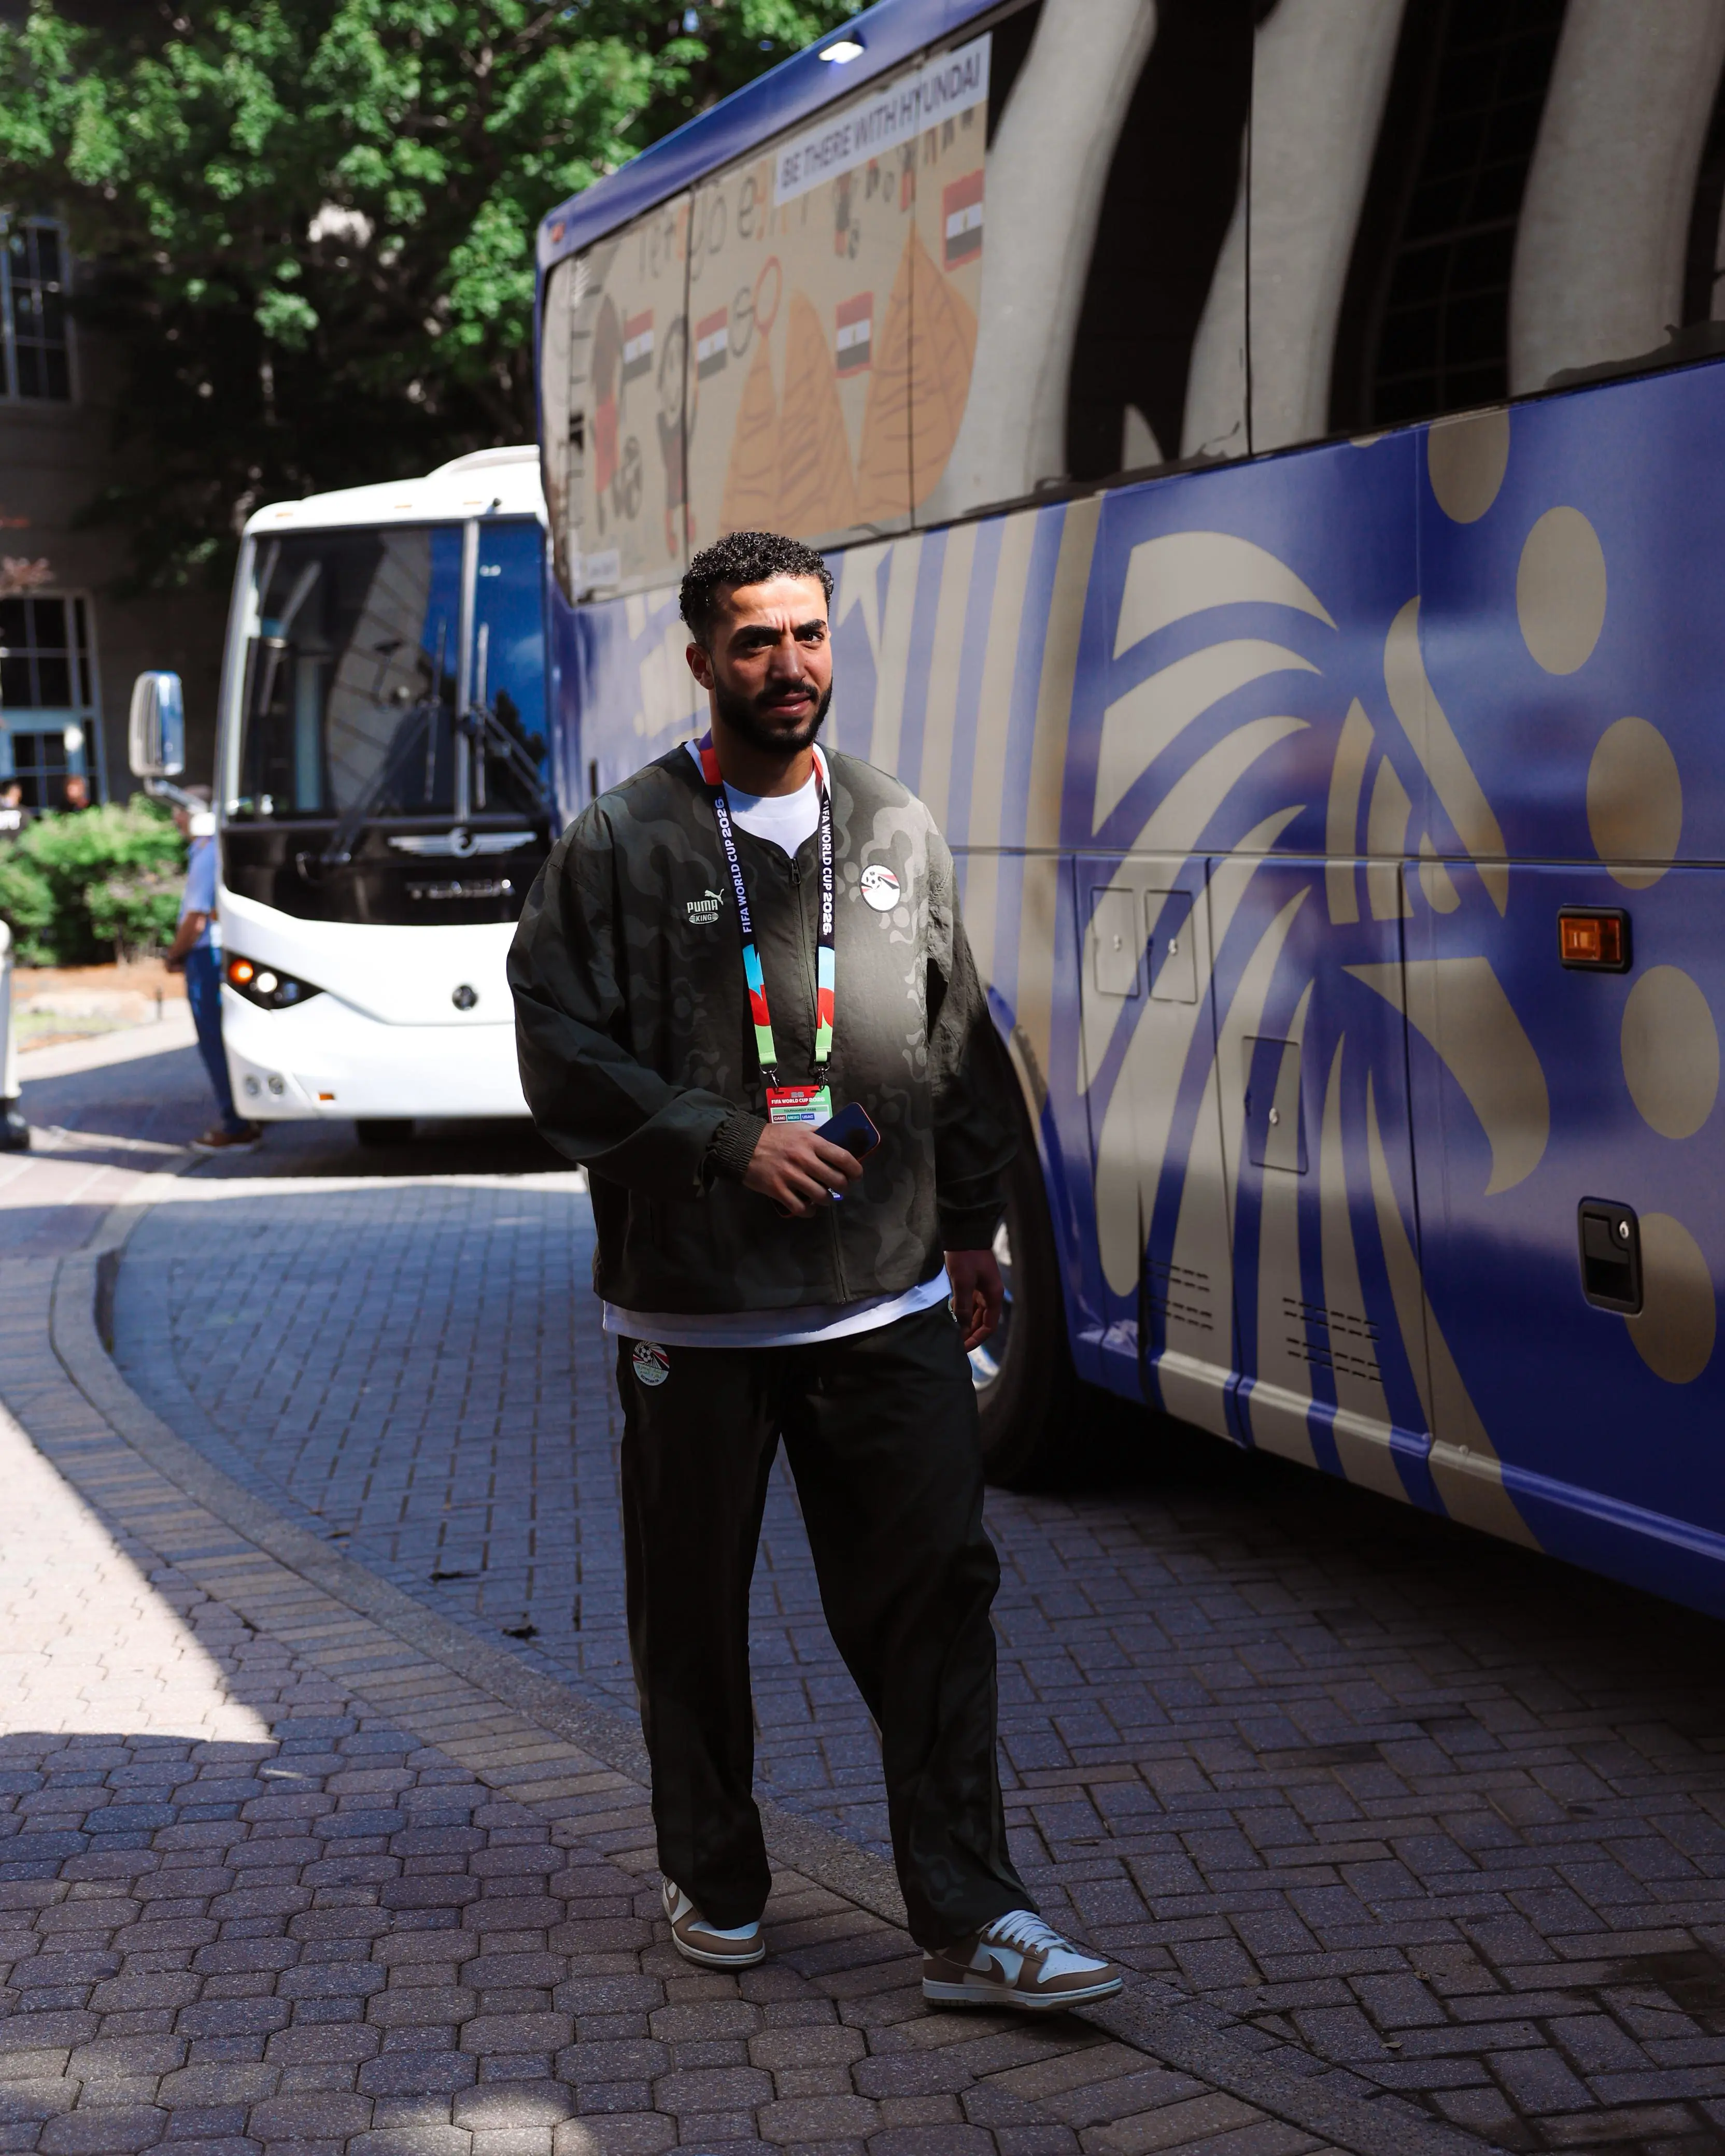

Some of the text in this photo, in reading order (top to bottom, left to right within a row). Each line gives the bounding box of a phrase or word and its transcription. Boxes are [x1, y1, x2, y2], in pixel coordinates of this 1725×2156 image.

[781, 53, 980, 189] BE THERE WITH HYUNDAI
[715, 798, 752, 933] FIFA WORLD CUP 2026
[822, 824, 832, 866] WORLD
[823, 868, 832, 891] CUP
[687, 899, 718, 913] PUMA
[696, 914, 712, 922] KING
[823, 892, 832, 934] 2026
